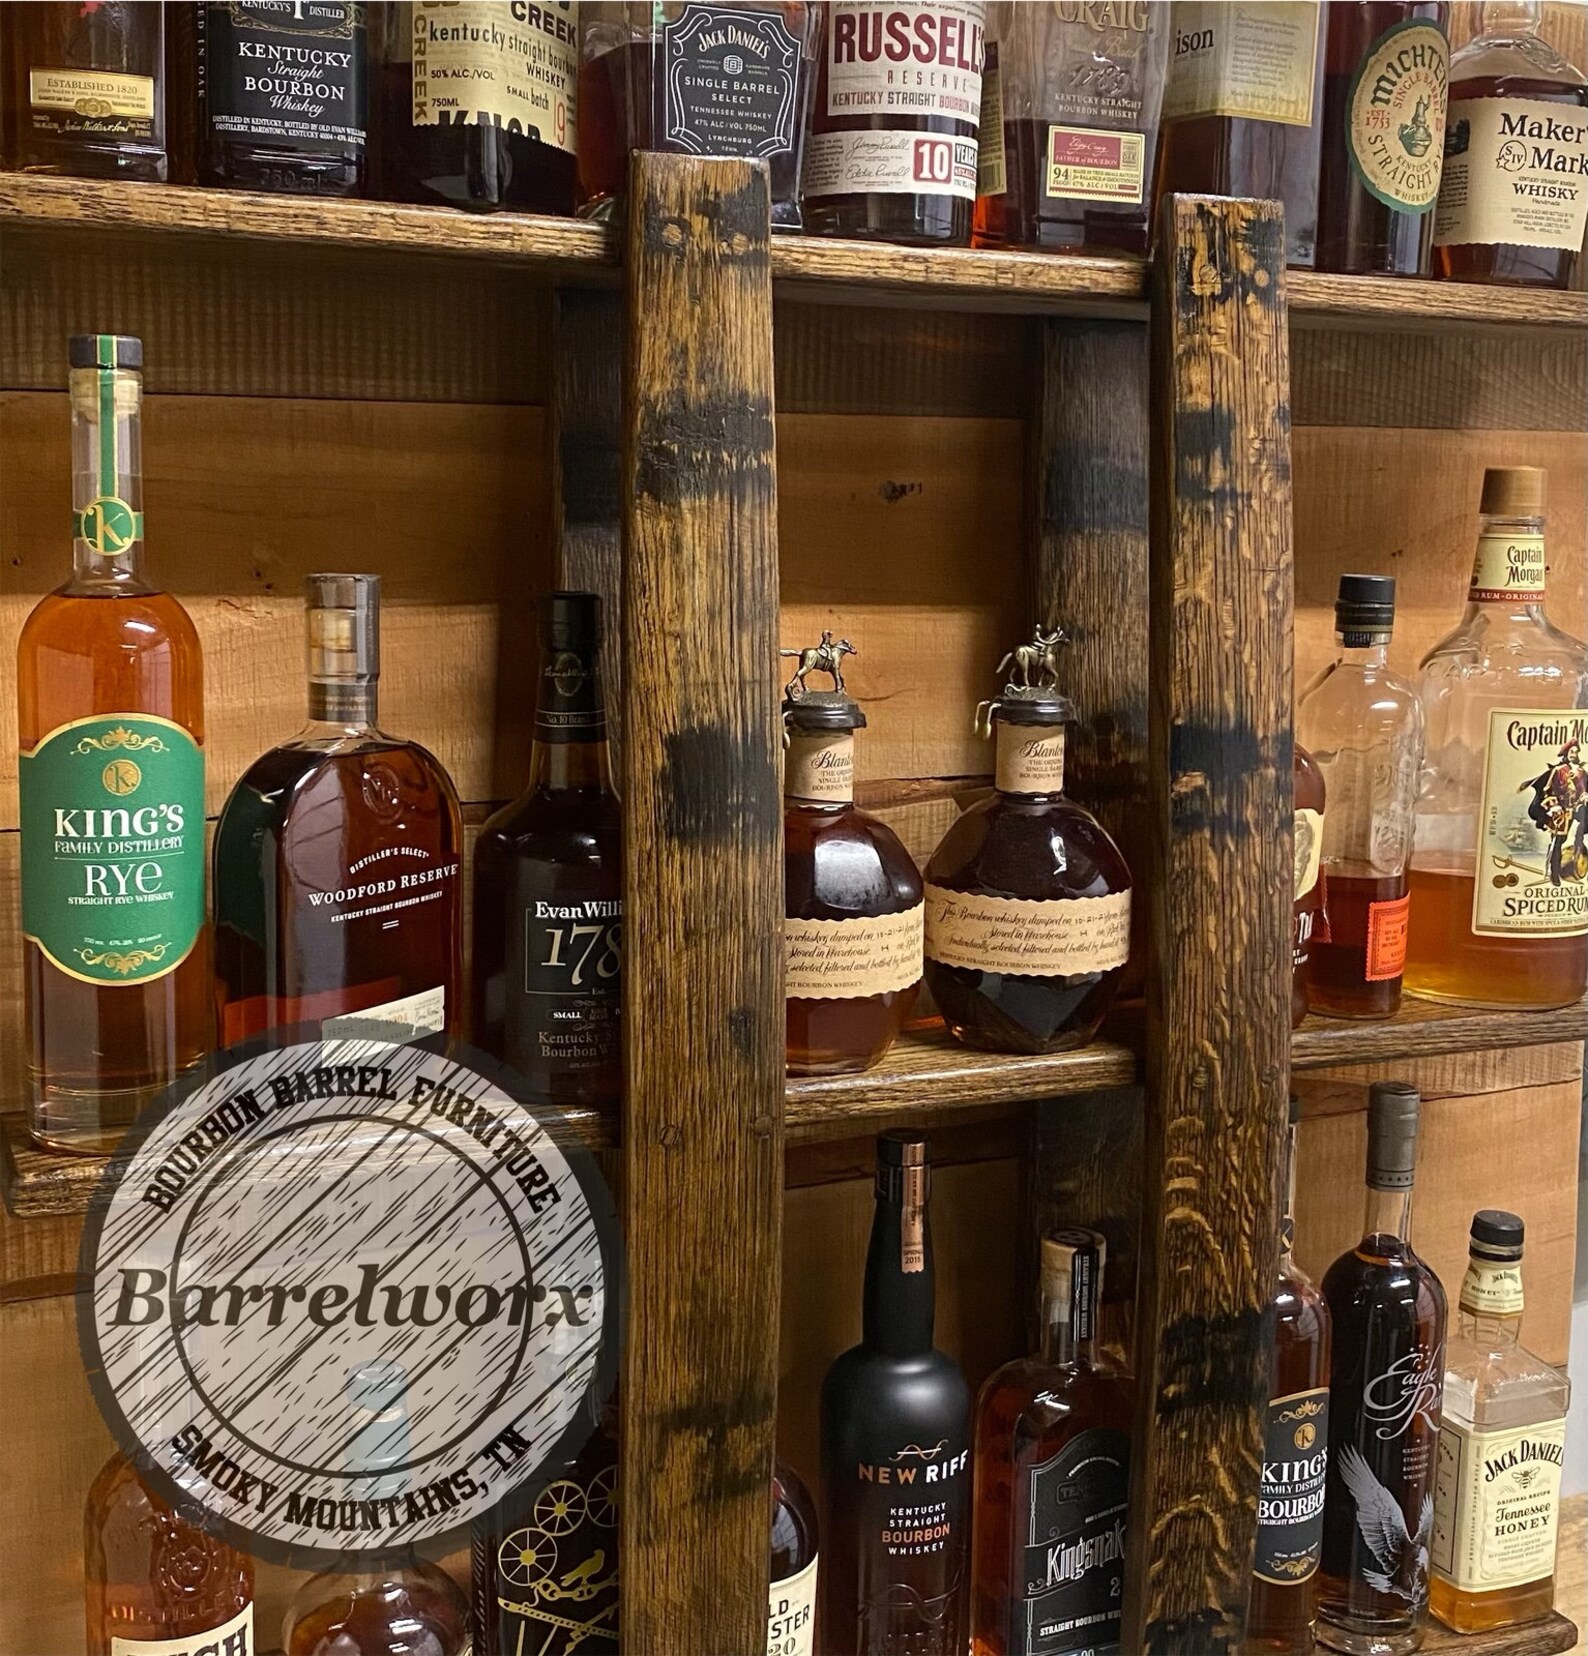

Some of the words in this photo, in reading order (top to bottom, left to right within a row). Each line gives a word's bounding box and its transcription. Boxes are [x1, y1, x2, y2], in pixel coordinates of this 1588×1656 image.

[309, 6, 345, 19] DISTILLER
[511, 1, 577, 48] CREEK
[430, 20, 506, 51] kentucky
[508, 33, 546, 63] straight
[698, 30, 727, 52] JACK
[728, 25, 771, 59] DANIEL'S
[1175, 29, 1214, 55] ison
[239, 42, 352, 67] KENTUCKY
[268, 60, 324, 81] Straight
[414, 14, 427, 120] CREEK
[431, 69, 448, 79] 50%
[527, 63, 566, 90] WHISKEY
[48, 79, 114, 92] ESTABLISHED
[117, 85, 137, 94] 1820
[245, 77, 345, 100] BOURBON
[685, 76, 728, 89] SINGLE
[733, 82, 780, 95] BARREL
[888, 70, 969, 92] RESERVE
[507, 86, 529, 101] SMALL
[531, 88, 549, 110] batch
[712, 93, 752, 105] SELECT
[833, 91, 883, 107] KENTUCKY
[888, 92, 936, 105] STRAIGHT
[1055, 93, 1099, 105] KENTUCKY
[1101, 98, 1142, 110] STRAIGHT
[1393, 71, 1421, 109] SINGLE
[1423, 72, 1439, 113] BARREL
[270, 95, 326, 117] Whiskey
[432, 98, 459, 107] 750ML
[690, 105, 735, 116] TENNESSEE
[738, 111, 772, 119] WHISKEY
[1058, 104, 1098, 115] BOURBON
[1101, 109, 1138, 119] WHISKEY
[745, 123, 767, 132] 750ML
[1366, 117, 1390, 129] 1753
[708, 134, 752, 144] LYNCHBURG
[919, 143, 949, 181] 10
[1368, 134, 1433, 190] STRAIGHT
[1396, 154, 1431, 172] KENTUCKY
[1528, 146, 1588, 177] Mark
[1053, 167, 1069, 180] 94
[1394, 190, 1430, 201] WHISKEY
[1512, 183, 1579, 200] WHISKY
[1507, 545, 1542, 566] Captain
[1507, 719, 1570, 751] Captain
[54, 804, 185, 838] KING'S
[54, 841, 104, 854] FAMILY
[108, 835, 184, 854] DISTILLERY
[349, 847, 398, 874] DISTILLER'S
[401, 847, 427, 859] SELECT
[308, 879, 396, 906] WOODFORD
[400, 864, 458, 889] RESERVE
[1524, 886, 1586, 898] ORIGINAL
[68, 895, 114, 905] STRAIGHT
[135, 891, 174, 903] WHISKEY
[331, 910, 364, 923] KENTUCKY
[365, 903, 394, 916] STRAIGHT
[394, 897, 420, 909] BOURBON
[421, 891, 443, 903] WHISKEY
[1503, 898, 1566, 917] SPICED
[535, 901, 583, 919] Evan
[960, 906, 994, 922] Bourbon
[995, 912, 1026, 927] whiskey
[1028, 913, 1064, 927] dumped
[794, 930, 828, 946] whiskey
[829, 929, 866, 945] dumped
[1024, 928, 1069, 941] Warehouse
[788, 945, 818, 959] Stored
[826, 947, 871, 959] Warehouse
[854, 961, 870, 971] and
[966, 957, 996, 967] STRAIGHT
[997, 961, 1031, 969] BOURBON
[553, 1011, 582, 1019] SMALL
[538, 1031, 600, 1044] Kentucky
[541, 1045, 597, 1058] Bourbon
[859, 1463, 917, 1485] NEW
[926, 1449, 968, 1483] RIFF
[1485, 1448, 1518, 1482] JACK
[890, 1502, 946, 1516] KENTUCKY
[1497, 1496, 1527, 1505] ORIGINAL
[889, 1513, 946, 1527] STRAIGHT
[1496, 1502, 1551, 1523] Tennessee
[882, 1522, 951, 1543] BOURBON
[1495, 1515, 1550, 1536] HONEY
[888, 1541, 944, 1555] WHISKEY
[1040, 1620, 1074, 1636] STRAIGHT
[1075, 1612, 1106, 1627] BOURBON
